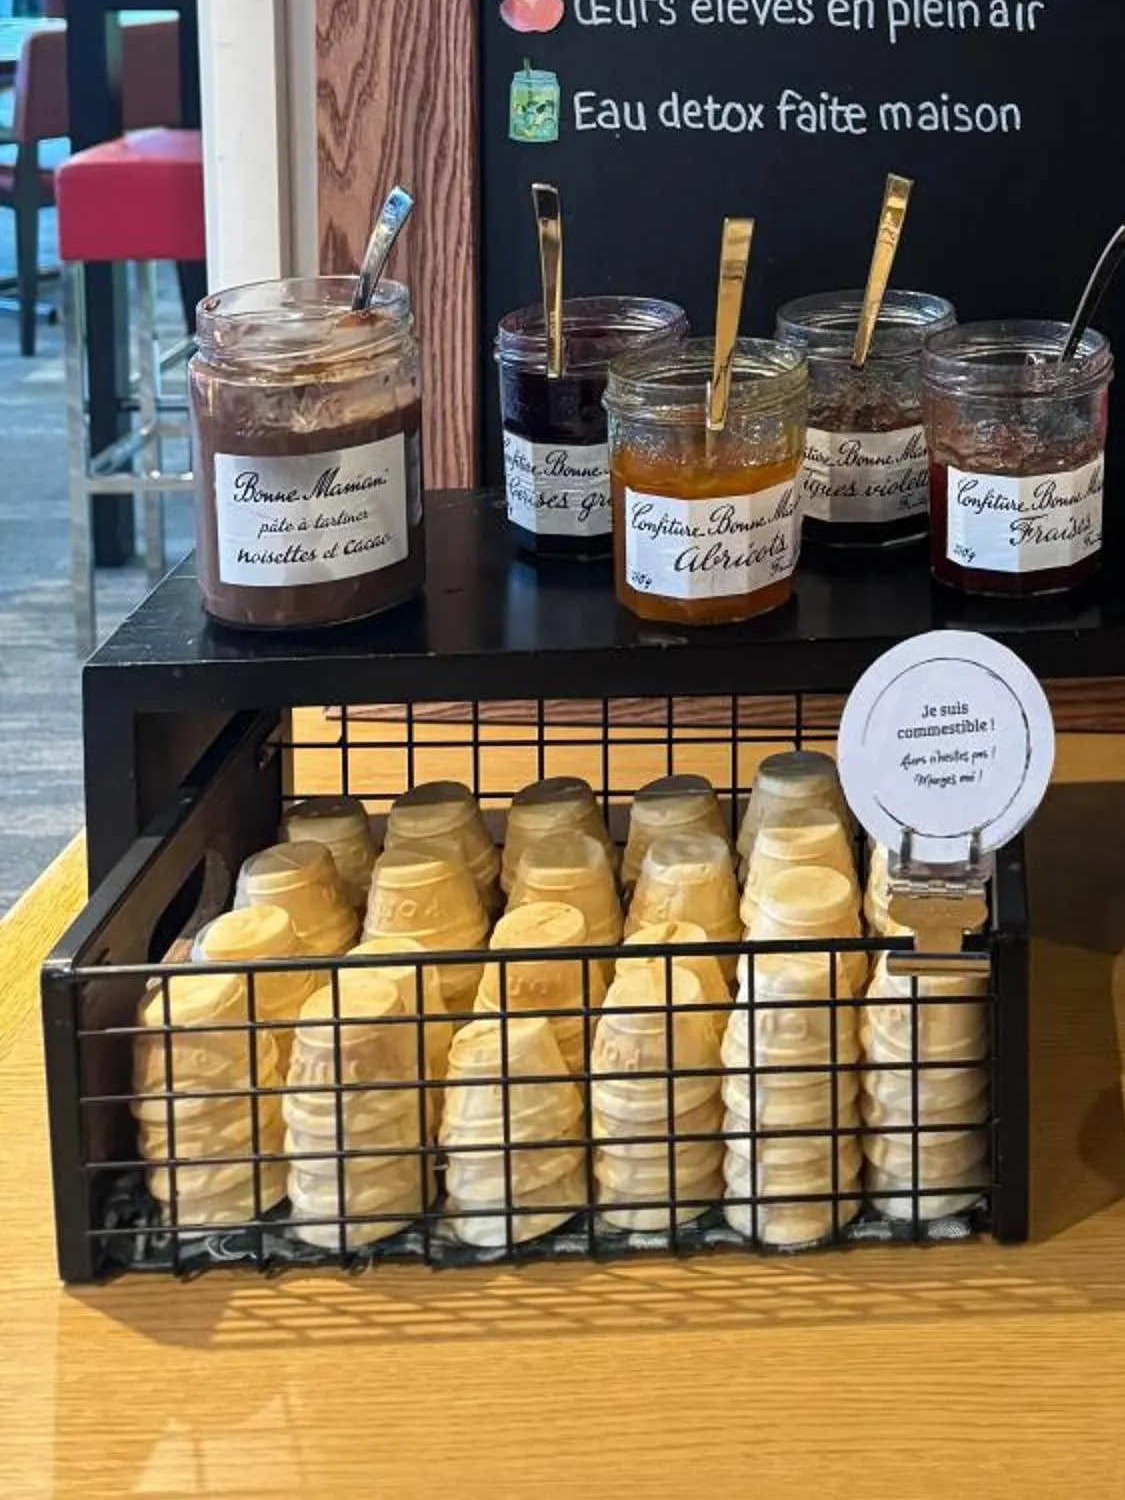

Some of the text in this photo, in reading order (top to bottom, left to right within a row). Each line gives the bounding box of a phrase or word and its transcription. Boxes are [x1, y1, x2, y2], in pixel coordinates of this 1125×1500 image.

[573, 89, 1021, 135] Eau detox faite maison
[544, 449, 603, 477] Bonne
[836, 439, 896, 468] Bonne
[233, 471, 299, 503] Bonne
[957, 479, 1029, 515] Confiture
[631, 501, 705, 541] Confiture
[707, 503, 766, 536] Bonne
[1008, 513, 1092, 547] Fraises
[673, 530, 788, 573] Abricots
[921, 701, 969, 719] Je suis
[897, 718, 988, 739] commestible
